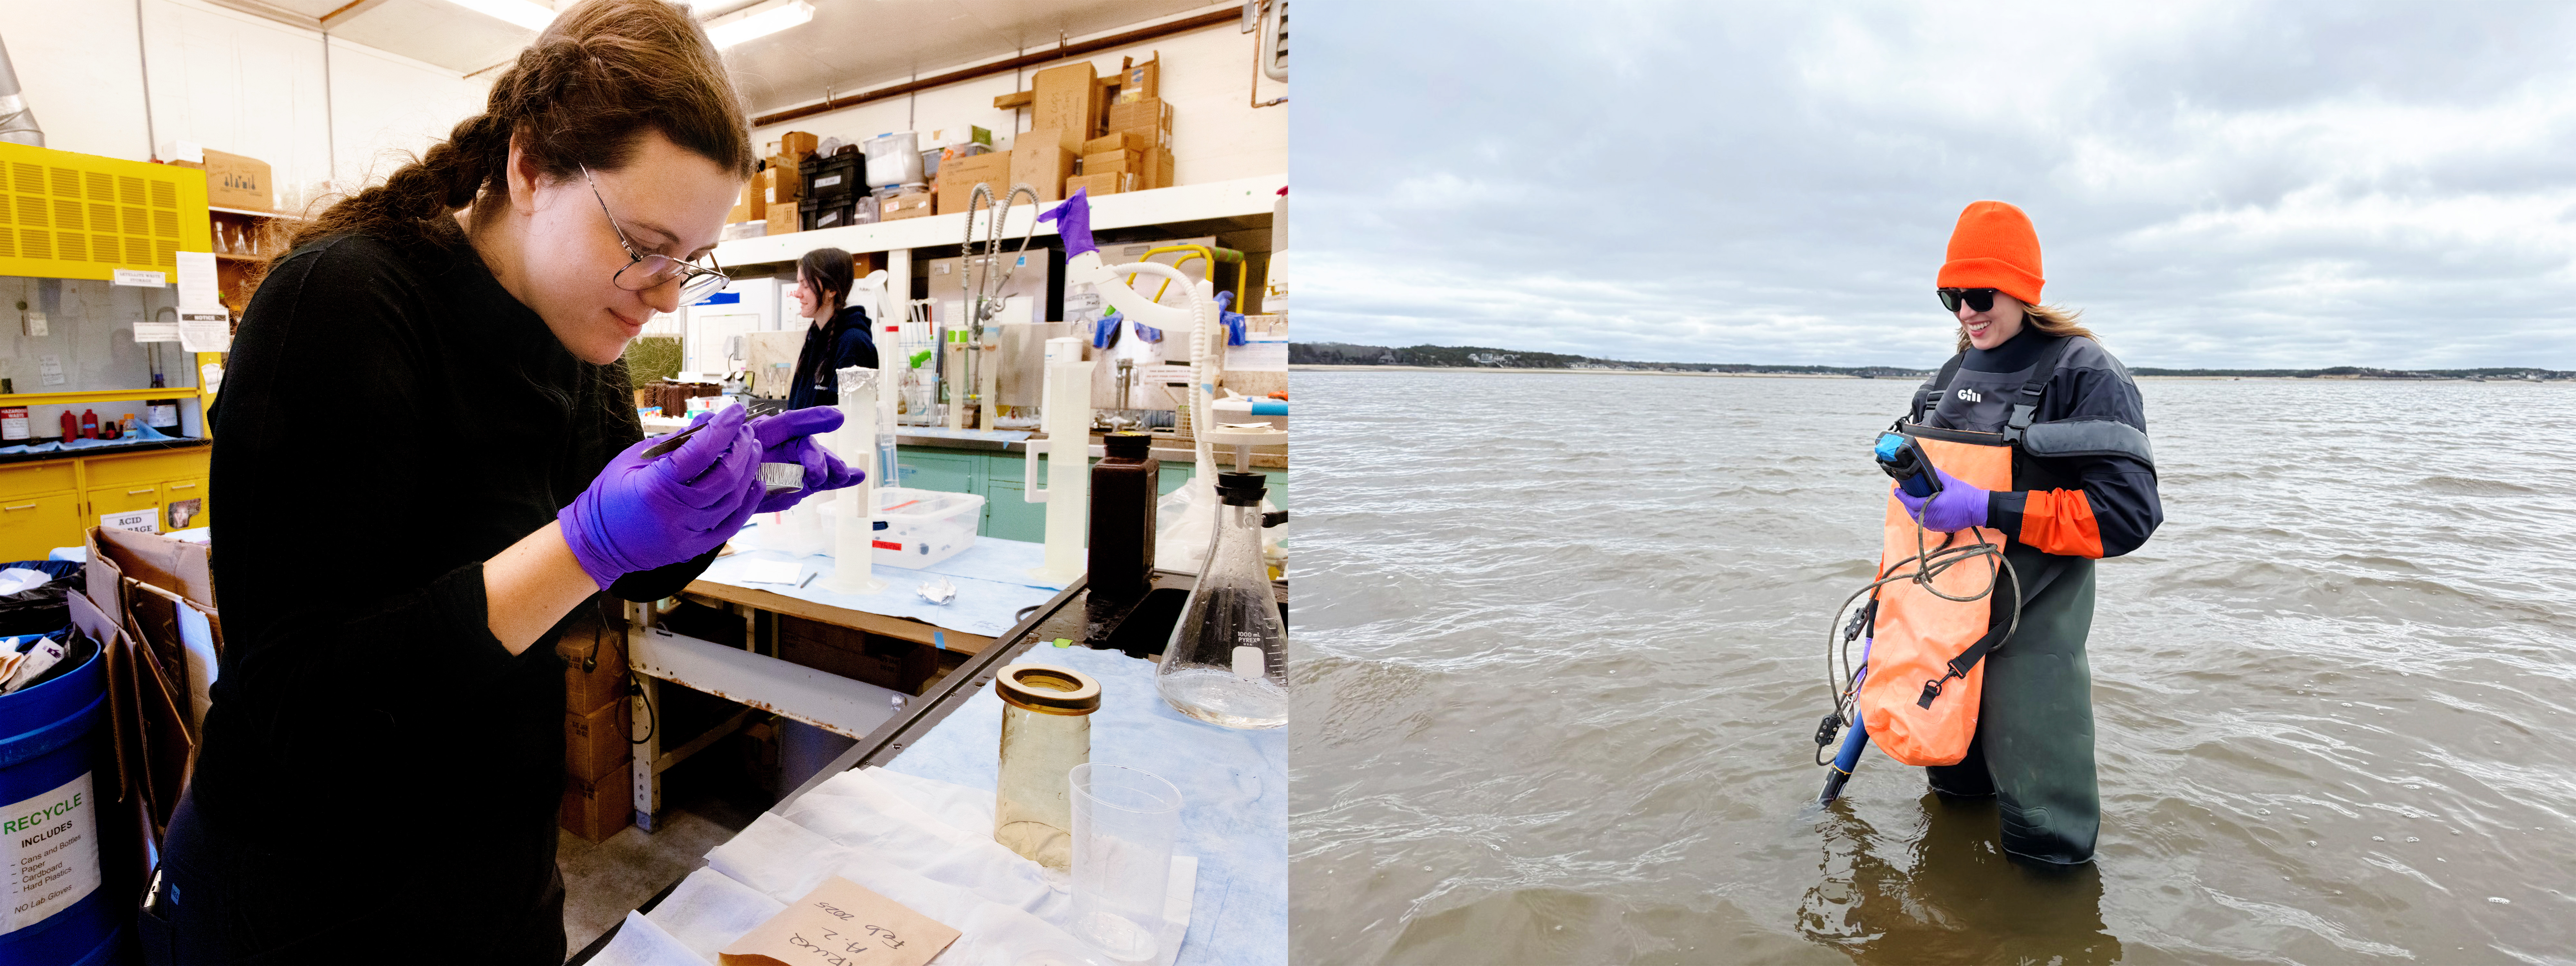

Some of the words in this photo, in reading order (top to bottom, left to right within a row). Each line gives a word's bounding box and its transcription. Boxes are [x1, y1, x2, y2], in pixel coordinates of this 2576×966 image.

[1958, 389, 1981, 403] Gill
[119, 516, 142, 526] ACID
[4, 793, 82, 835] RECYCLE
[22, 820, 72, 848] INCLUDES
[21, 854, 42, 865] Cans
[44, 845, 58, 857] and
[60, 835, 81, 849] Bottles
[22, 861, 45, 874] Paper
[23, 861, 62, 883] Cardboard
[24, 880, 43, 892] Hard
[45, 867, 72, 884] Plastics
[15, 904, 28, 914] NO
[31, 897, 45, 908] Lab
[48, 885, 72, 900] Gloves
[813, 902, 855, 921] 2025
[865, 925, 905, 950] Feb
